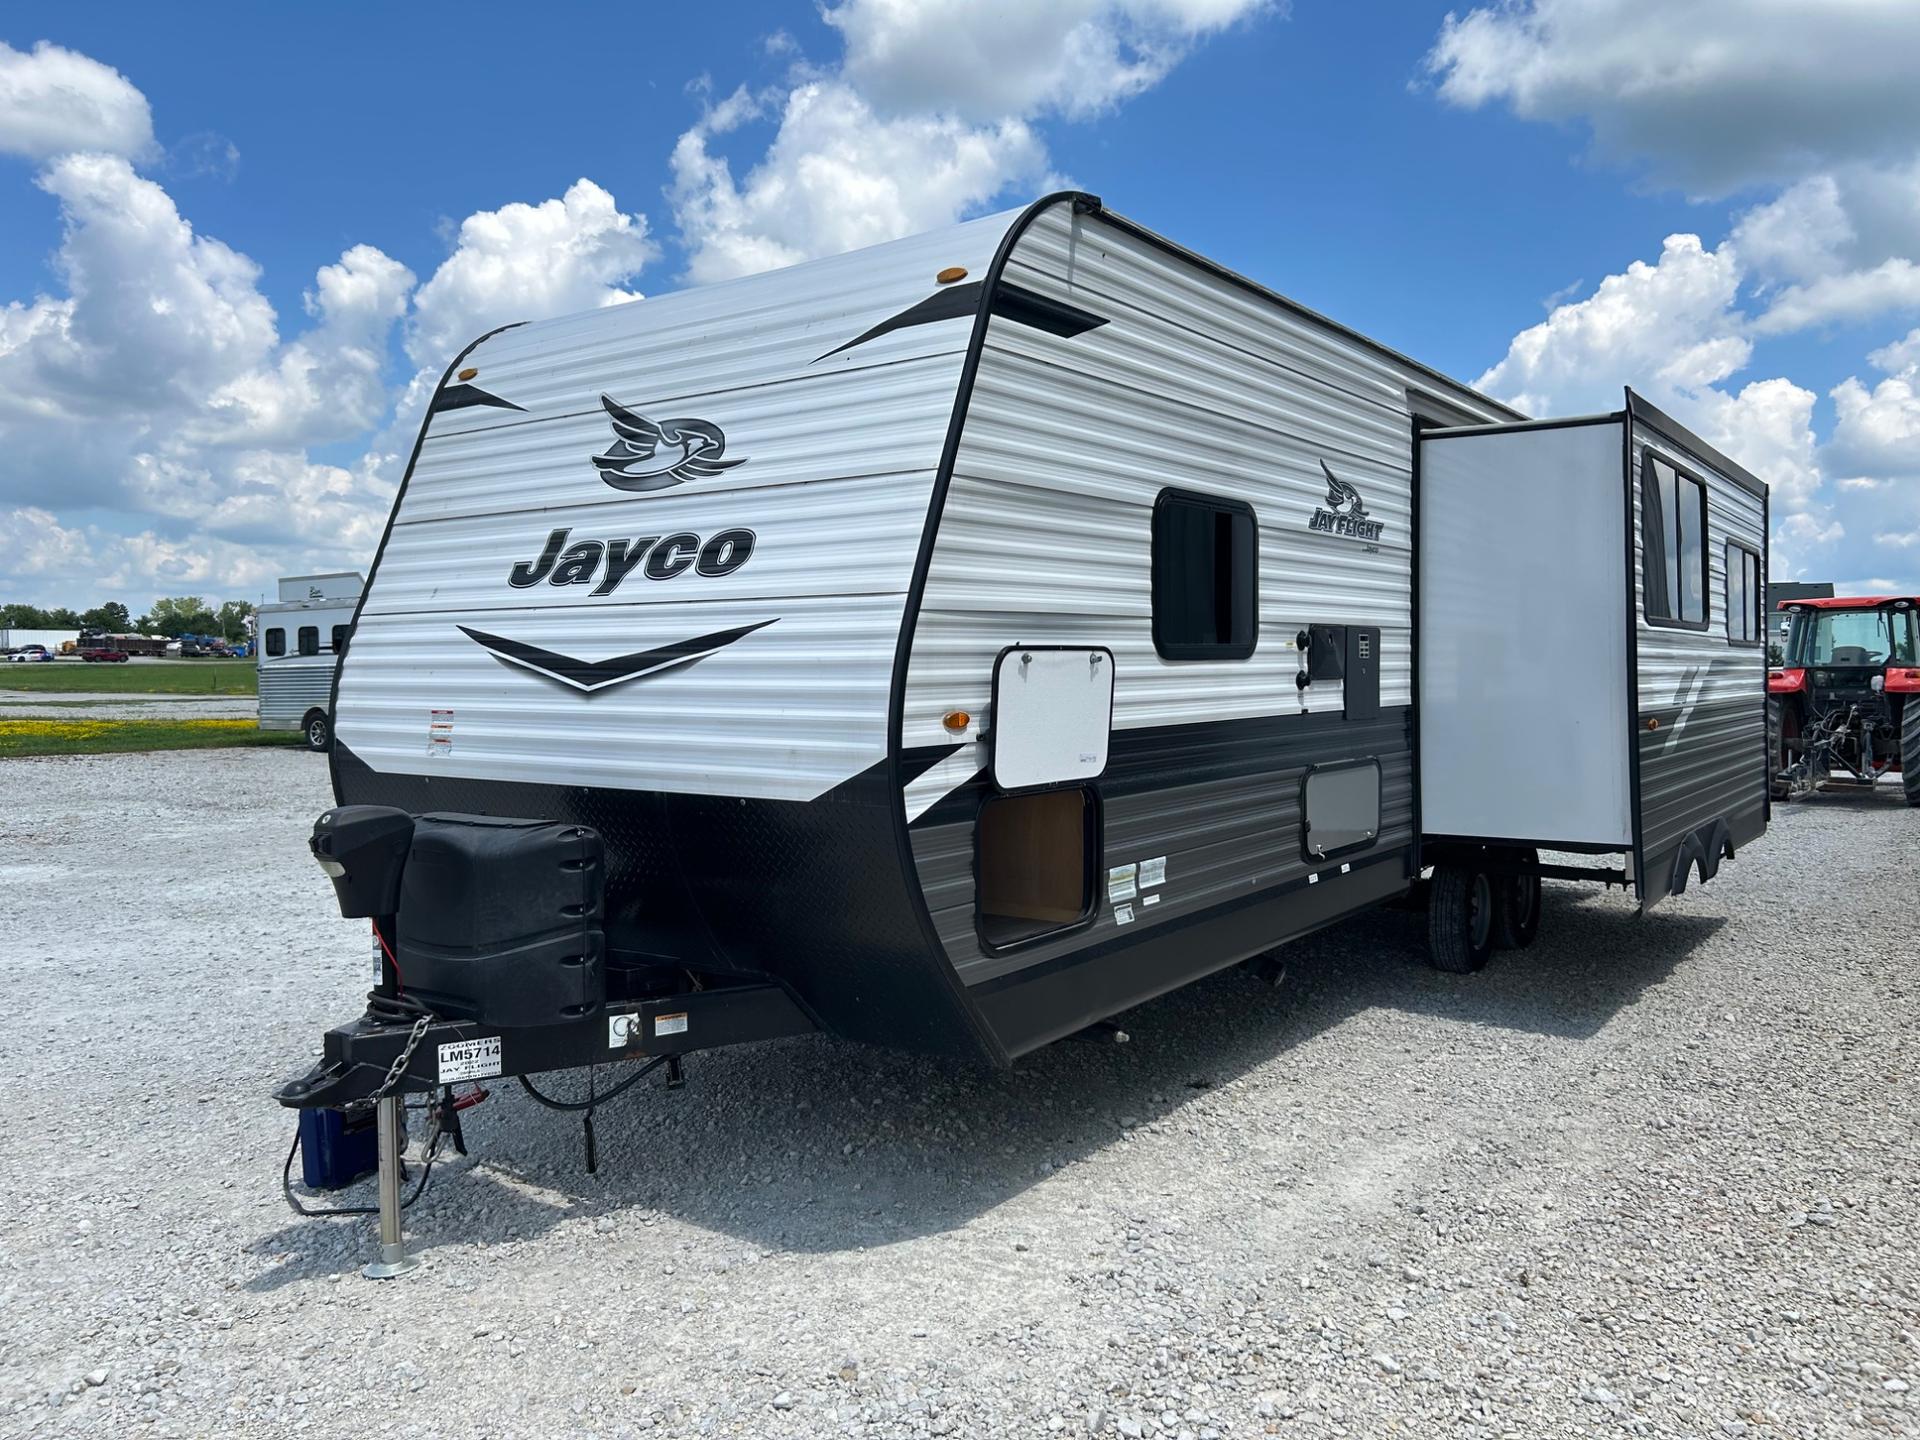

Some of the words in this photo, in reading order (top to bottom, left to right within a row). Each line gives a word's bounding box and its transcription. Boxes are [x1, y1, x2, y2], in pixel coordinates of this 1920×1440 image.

[1308, 507, 1337, 532] JAY
[1336, 515, 1384, 541] FLIGHT
[508, 527, 757, 597] Jayco
[441, 1045, 500, 1063] LM5714
[464, 1061, 500, 1070] FLIGHT
